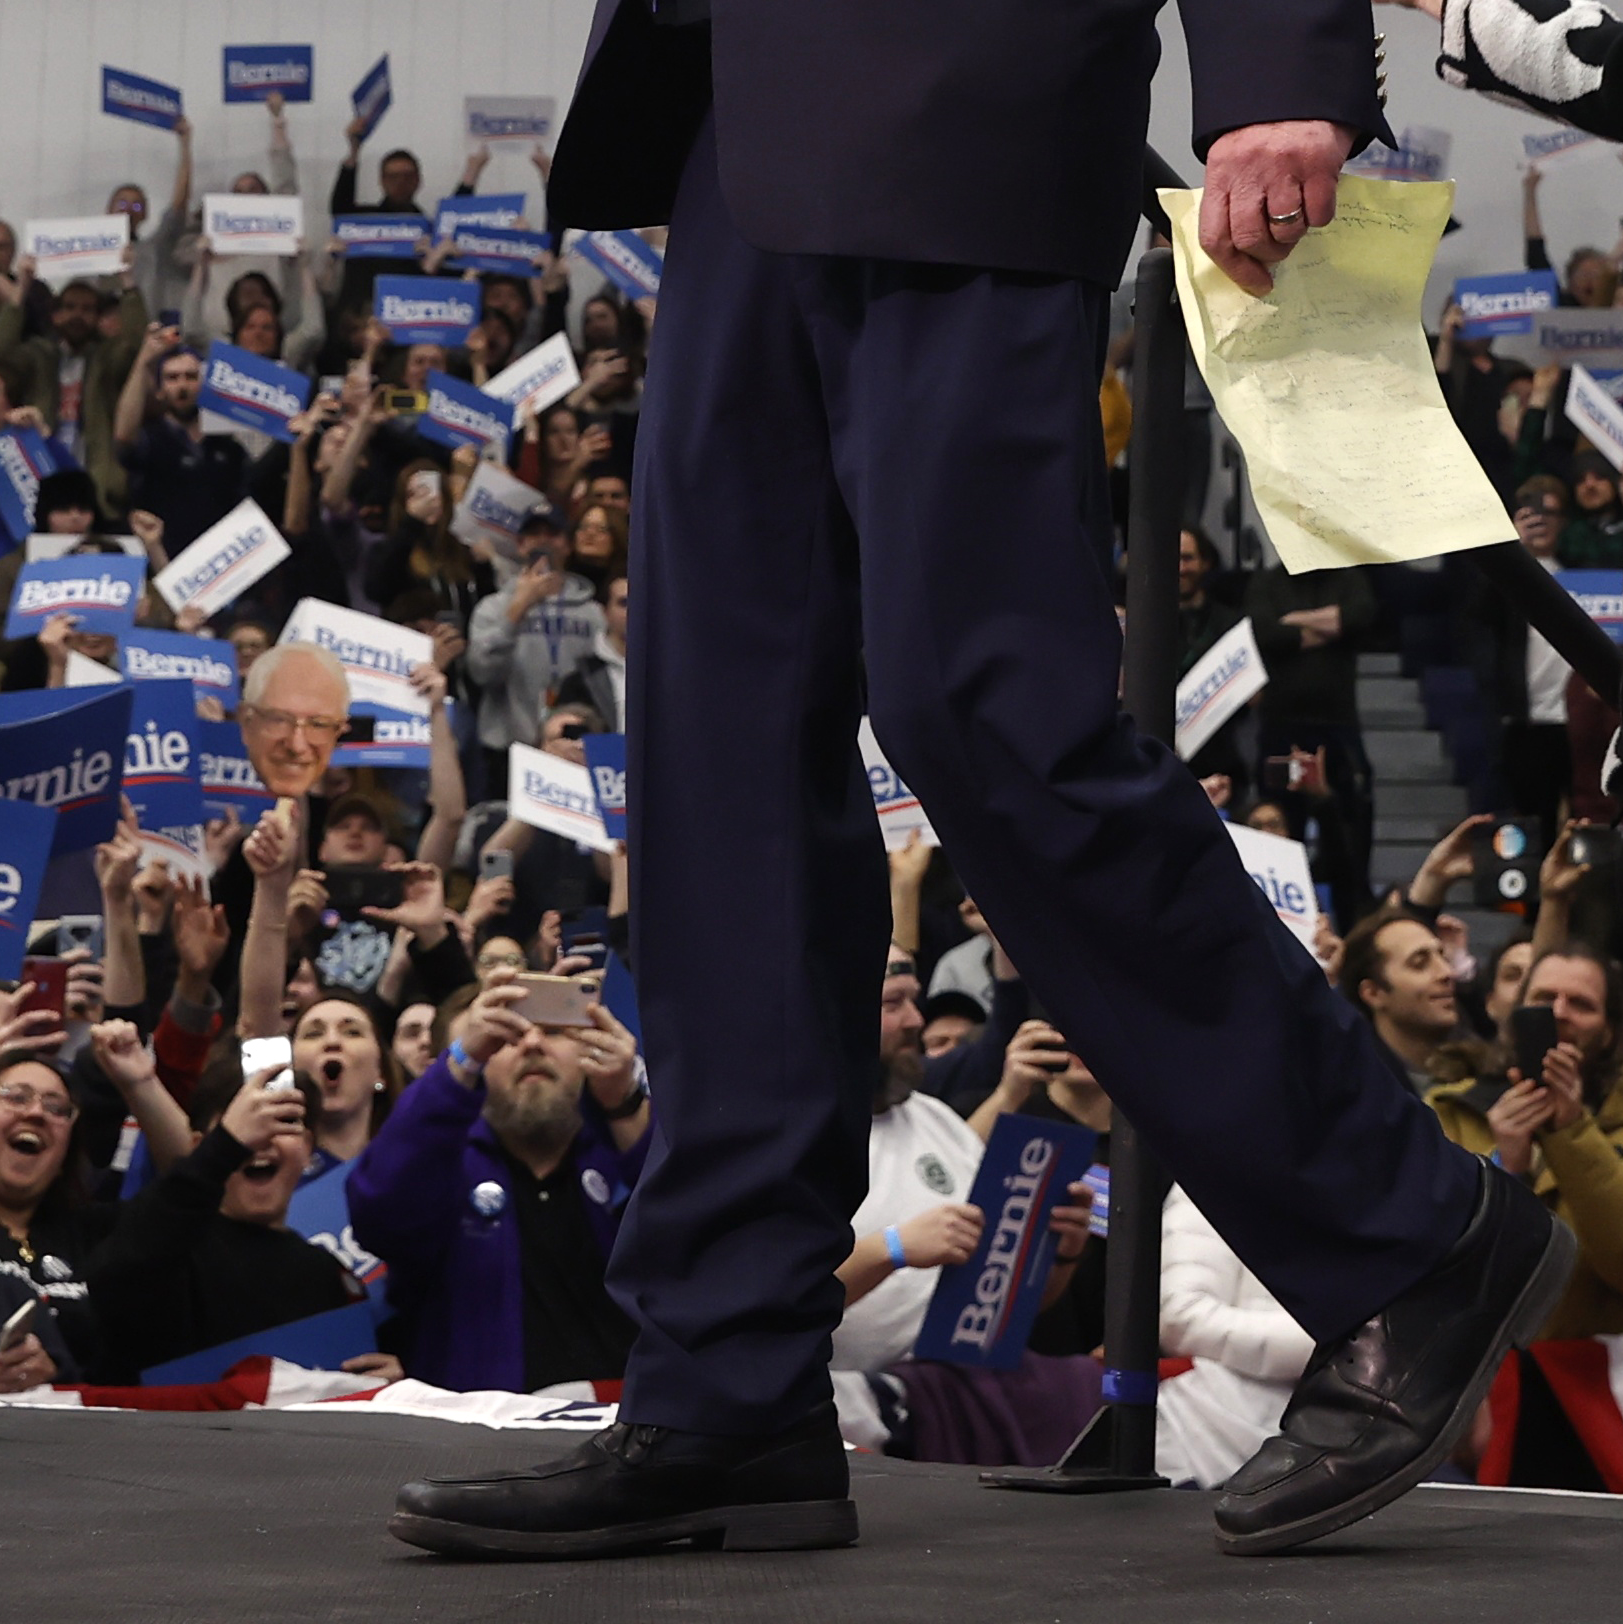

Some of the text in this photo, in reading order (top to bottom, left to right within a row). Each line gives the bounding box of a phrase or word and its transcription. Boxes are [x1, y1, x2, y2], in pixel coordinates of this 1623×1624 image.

[18, 574, 133, 612] Bernie
[126, 646, 232, 687] Bernie
[950, 1137, 1054, 1348] Bernie
